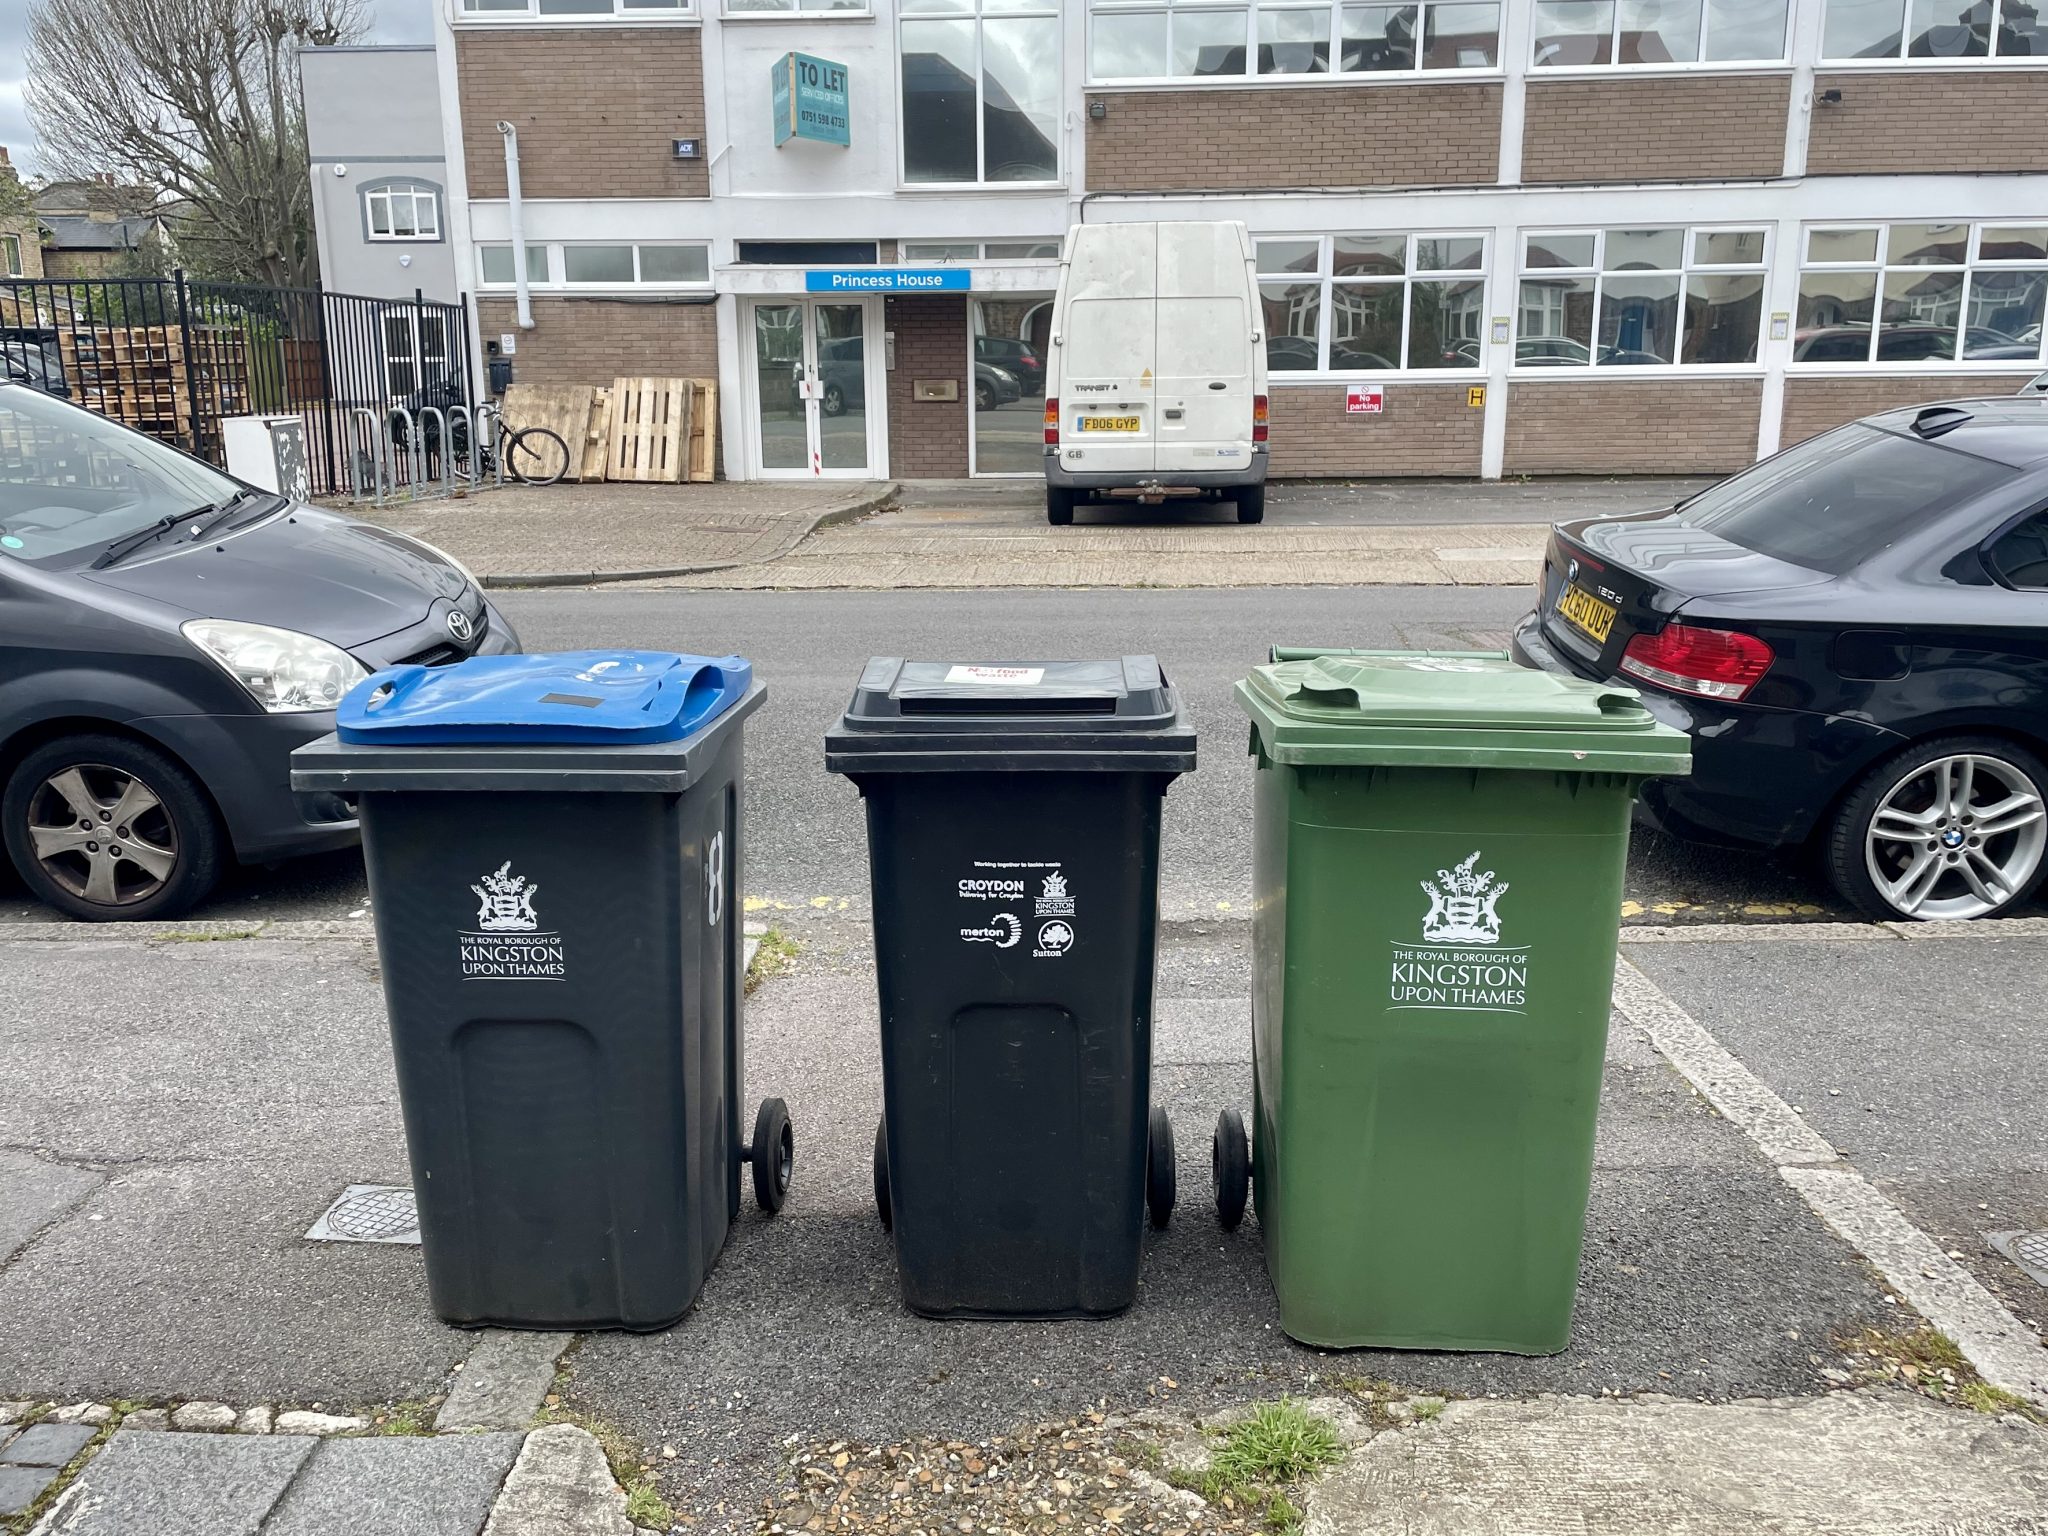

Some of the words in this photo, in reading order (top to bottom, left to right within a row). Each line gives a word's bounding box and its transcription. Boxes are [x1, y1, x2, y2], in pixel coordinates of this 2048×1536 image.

[799, 61, 818, 86] TO
[824, 67, 844, 92] LET
[801, 110, 816, 123] 0751
[831, 116, 845, 128] 4733
[680, 144, 693, 152] ADT
[832, 274, 892, 287] Princess
[897, 274, 943, 286] House
[1470, 389, 1483, 404] H
[1350, 402, 1379, 411] parking
[1084, 418, 1113, 429] FD06
[1116, 418, 1138, 429] GYP
[1068, 450, 1083, 458] GB
[709, 831, 723, 926] 8
[958, 879, 1024, 892] CROYDON
[988, 891, 997, 899] for
[960, 928, 1004, 937] merton
[477, 937, 502, 945] ROYAL
[505, 937, 548, 945] BOROUGH
[550, 937, 561, 945] OF
[460, 946, 563, 962] KINGSTON
[1033, 949, 1062, 957] Sutton
[1393, 950, 1413, 960] THE
[1416, 951, 1450, 961] ROYAL
[1453, 953, 1509, 964] BOROUGH
[1512, 955, 1527, 964] OF
[462, 962, 504, 974] UPON
[507, 963, 565, 975] THAMES
[1392, 962, 1527, 987] KINGSTON
[1391, 986, 1446, 1002] UPON
[1451, 988, 1525, 1005] THAMES
